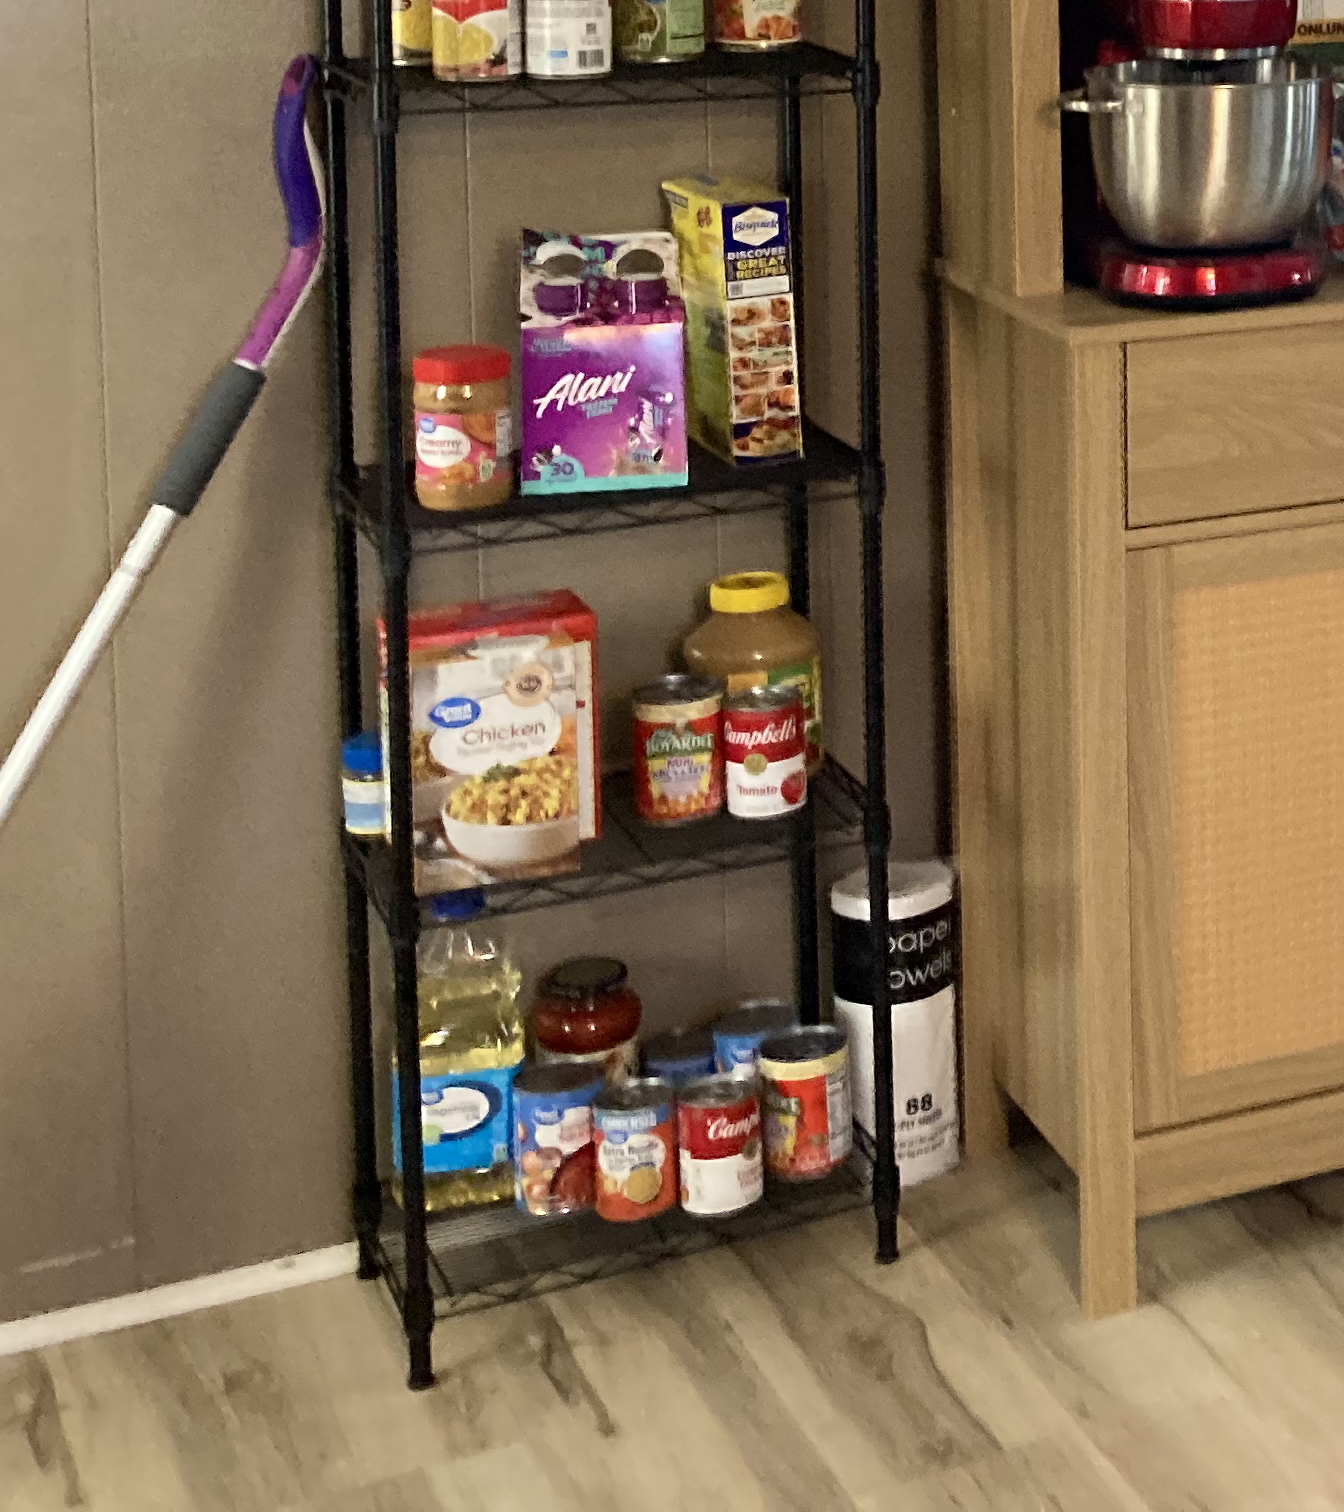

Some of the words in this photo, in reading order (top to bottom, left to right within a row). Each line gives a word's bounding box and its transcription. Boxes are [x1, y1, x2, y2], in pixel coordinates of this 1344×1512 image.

[727, 246, 786, 261] DISCOVER
[737, 254, 786, 271] GREAT
[533, 364, 637, 419] Alani
[551, 462, 575, 476] 30
[462, 722, 547, 746] Chicken
[736, 784, 778, 797] Tomato
